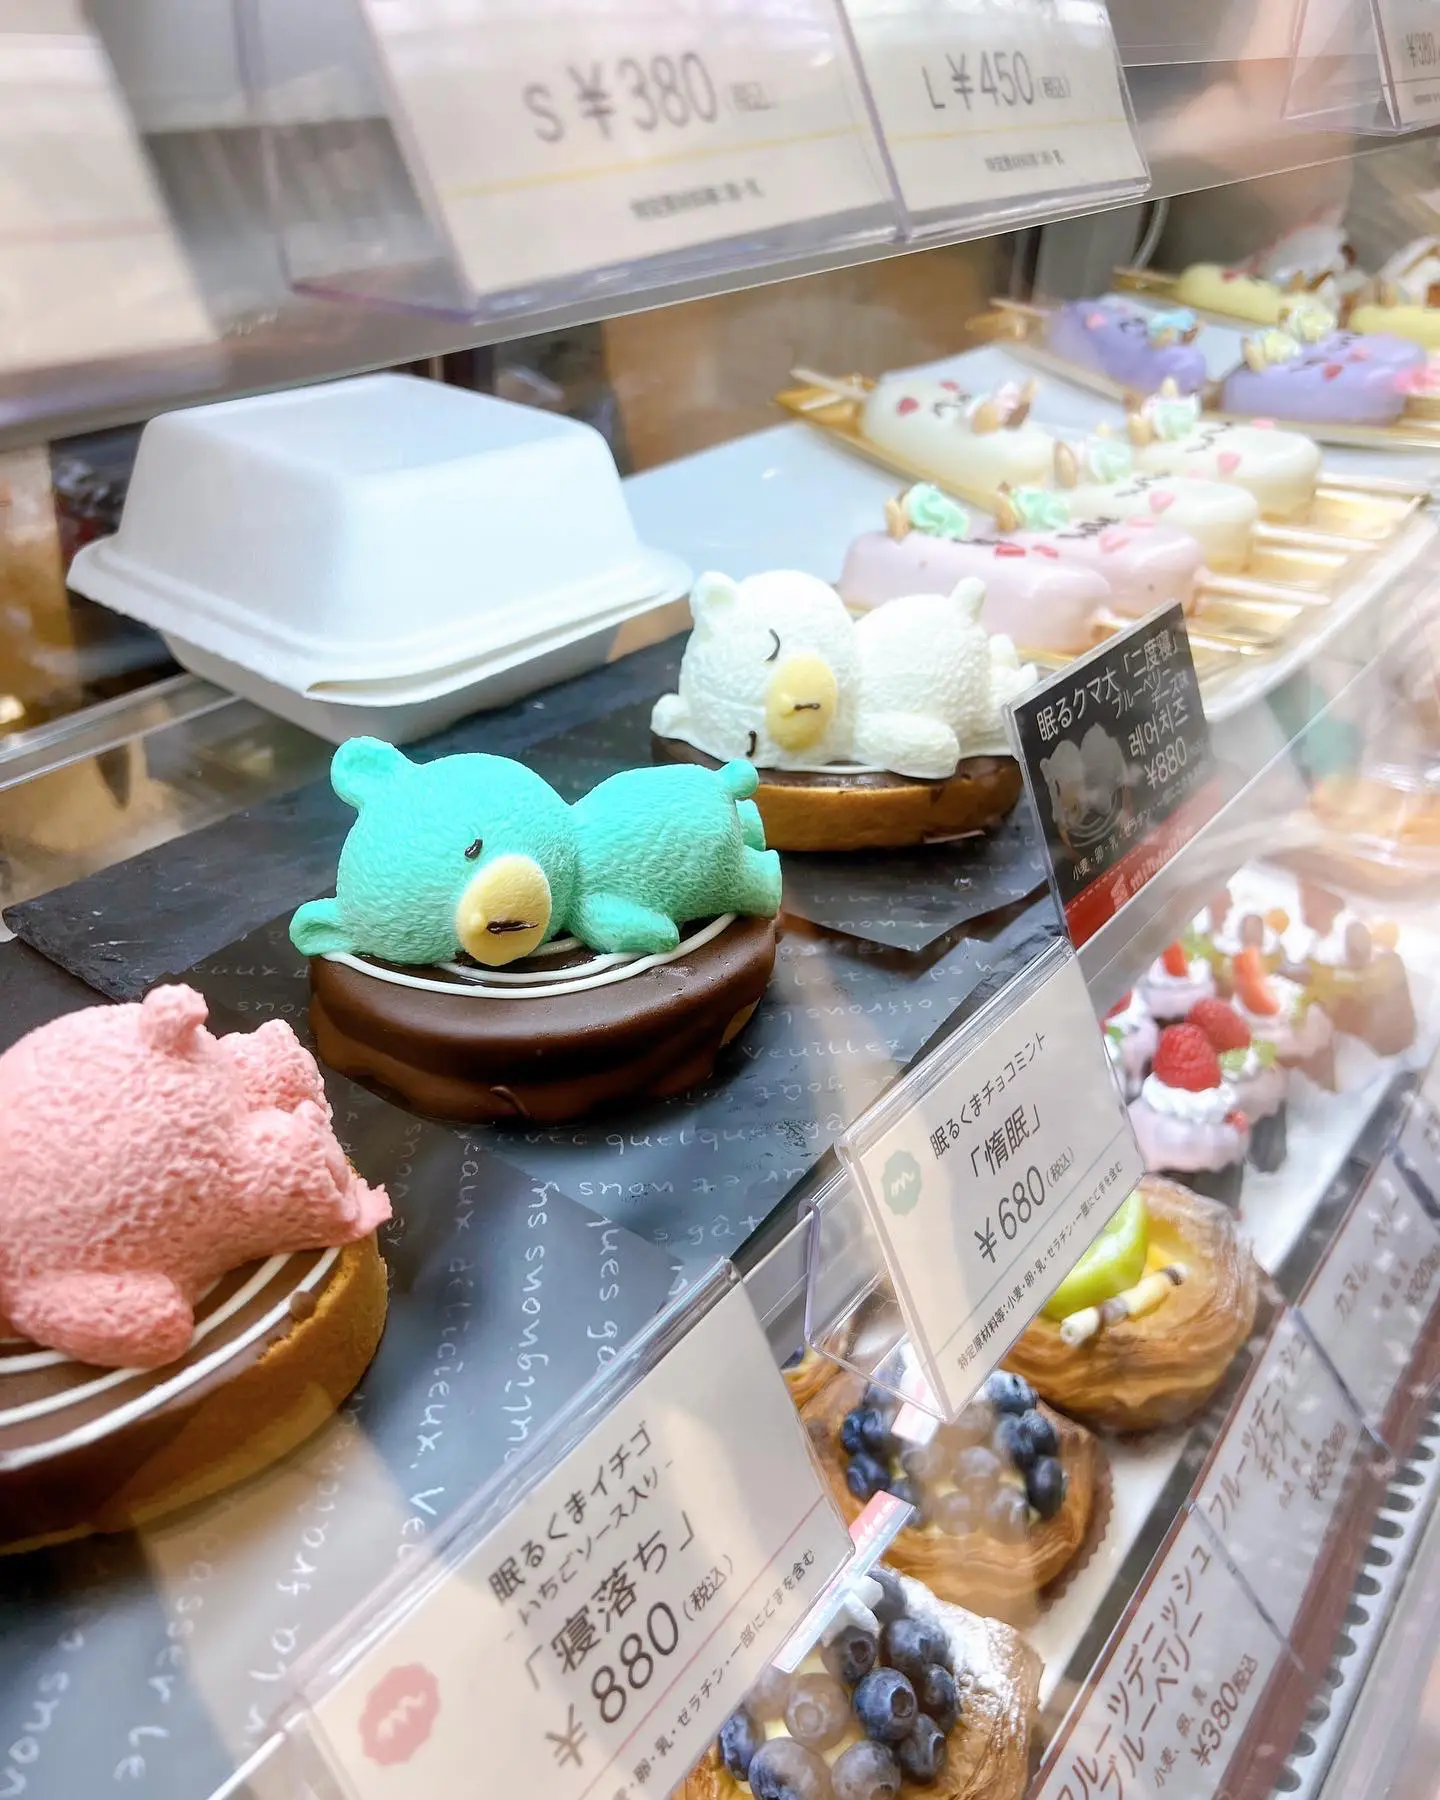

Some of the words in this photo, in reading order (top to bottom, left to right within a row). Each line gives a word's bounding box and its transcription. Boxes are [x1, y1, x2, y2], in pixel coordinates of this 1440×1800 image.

[522, 82, 565, 143] S
[565, 50, 719, 141] ¥380
[922, 66, 945, 110] L
[945, 49, 1035, 111] ¥450
[1128, 696, 1189, 757] 레어치즈
[1144, 736, 1189, 790] ¥880
[929, 1030, 1048, 1160] 眠るくまチョコミント
[970, 1102, 1041, 1179] 「惰眠」
[487, 1420, 652, 1608] 眠るくまイチゴ
[523, 1509, 697, 1692] 「寝落ち」
[1056, 1544, 1212, 1800] フルーツデニッシュ
[1099, 1610, 1203, 1800] ブルーベリー
